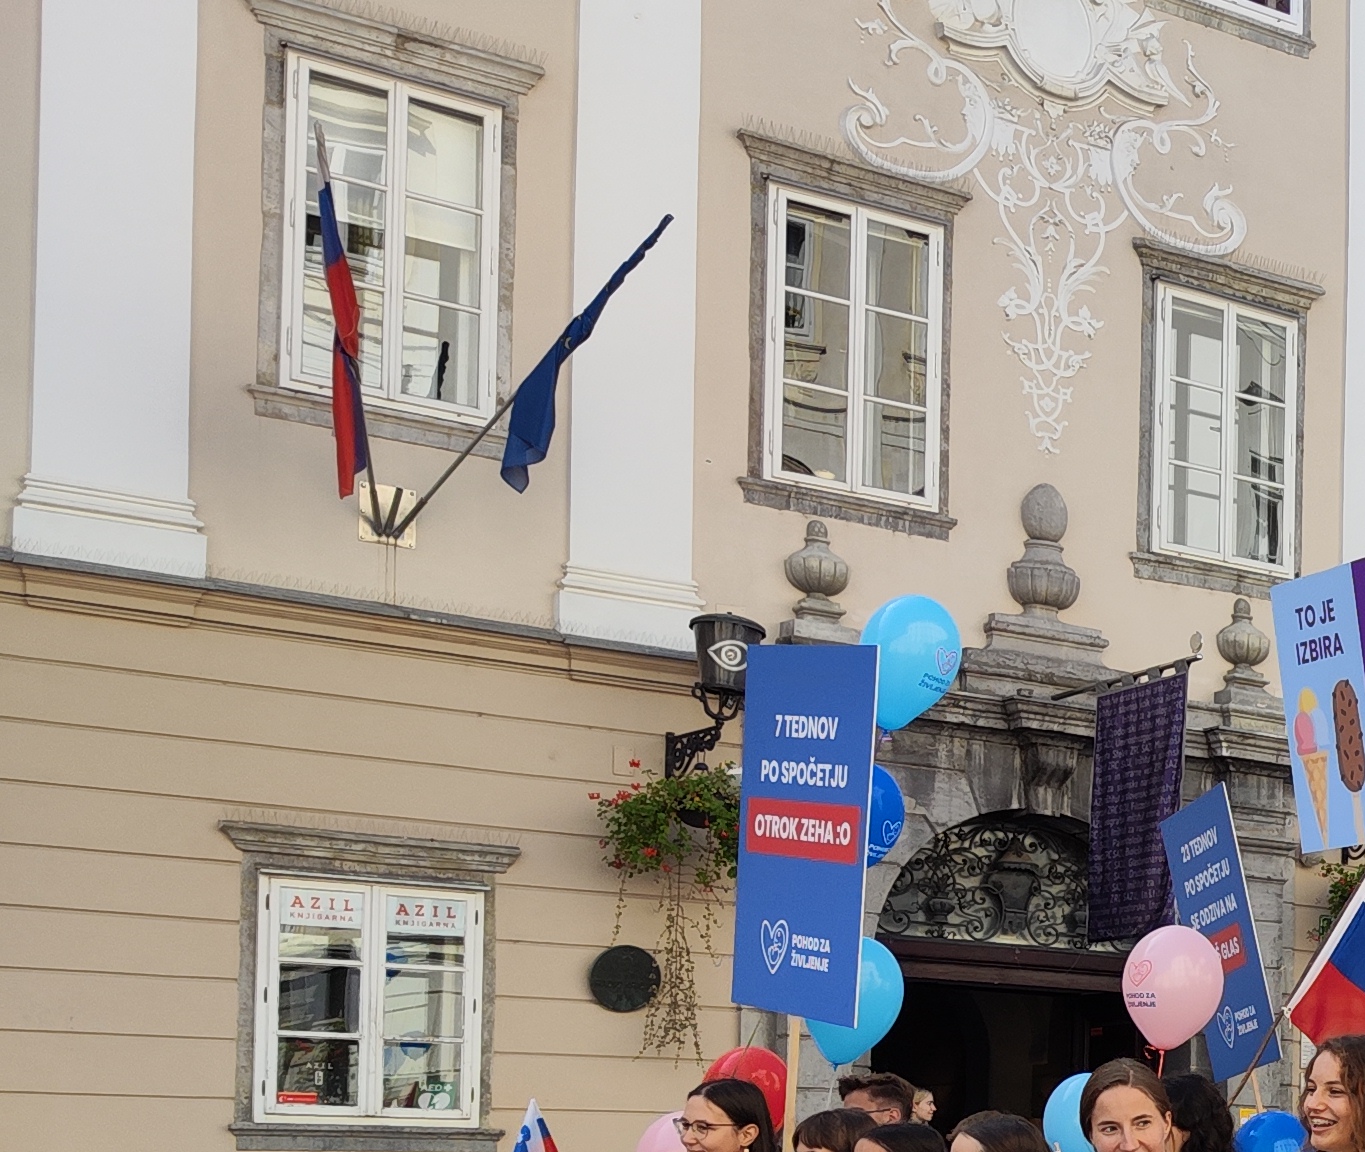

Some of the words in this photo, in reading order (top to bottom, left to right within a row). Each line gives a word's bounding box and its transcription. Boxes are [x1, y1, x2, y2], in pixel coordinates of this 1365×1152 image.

[1295, 604, 1316, 630] TO
[1319, 598, 1336, 624] JE
[1296, 632, 1344, 666] IZBIRA
[775, 715, 783, 737] 7
[784, 715, 839, 740] TEDNOV
[760, 760, 779, 783] PO
[780, 756, 849, 788] SPOČETJU
[754, 813, 799, 840] OTROK
[800, 818, 834, 845] ZEHA
[835, 822, 851, 846] :O
[1180, 846, 1191, 864] 23
[1189, 825, 1219, 859] TEDNOV
[1184, 880, 1195, 898] PO
[1194, 858, 1231, 894] SPOČETJU
[290, 896, 354, 912] AZIL
[395, 903, 457, 919] AZIL
[1190, 912, 1200, 931] SE
[1199, 899, 1228, 928] ODZIVA
[1225, 892, 1238, 915] NA
[289, 912, 354, 923] KNJIGARNA
[394, 919, 457, 929] KNJIGARNA
[791, 934, 819, 951] POHOD
[820, 939, 831, 953] ZA
[1221, 936, 1240, 960] GLAS
[790, 949, 829, 972] ŽIVLJENJE
[305, 1062, 334, 1070] AZIL
[420, 1083, 442, 1092] AED
